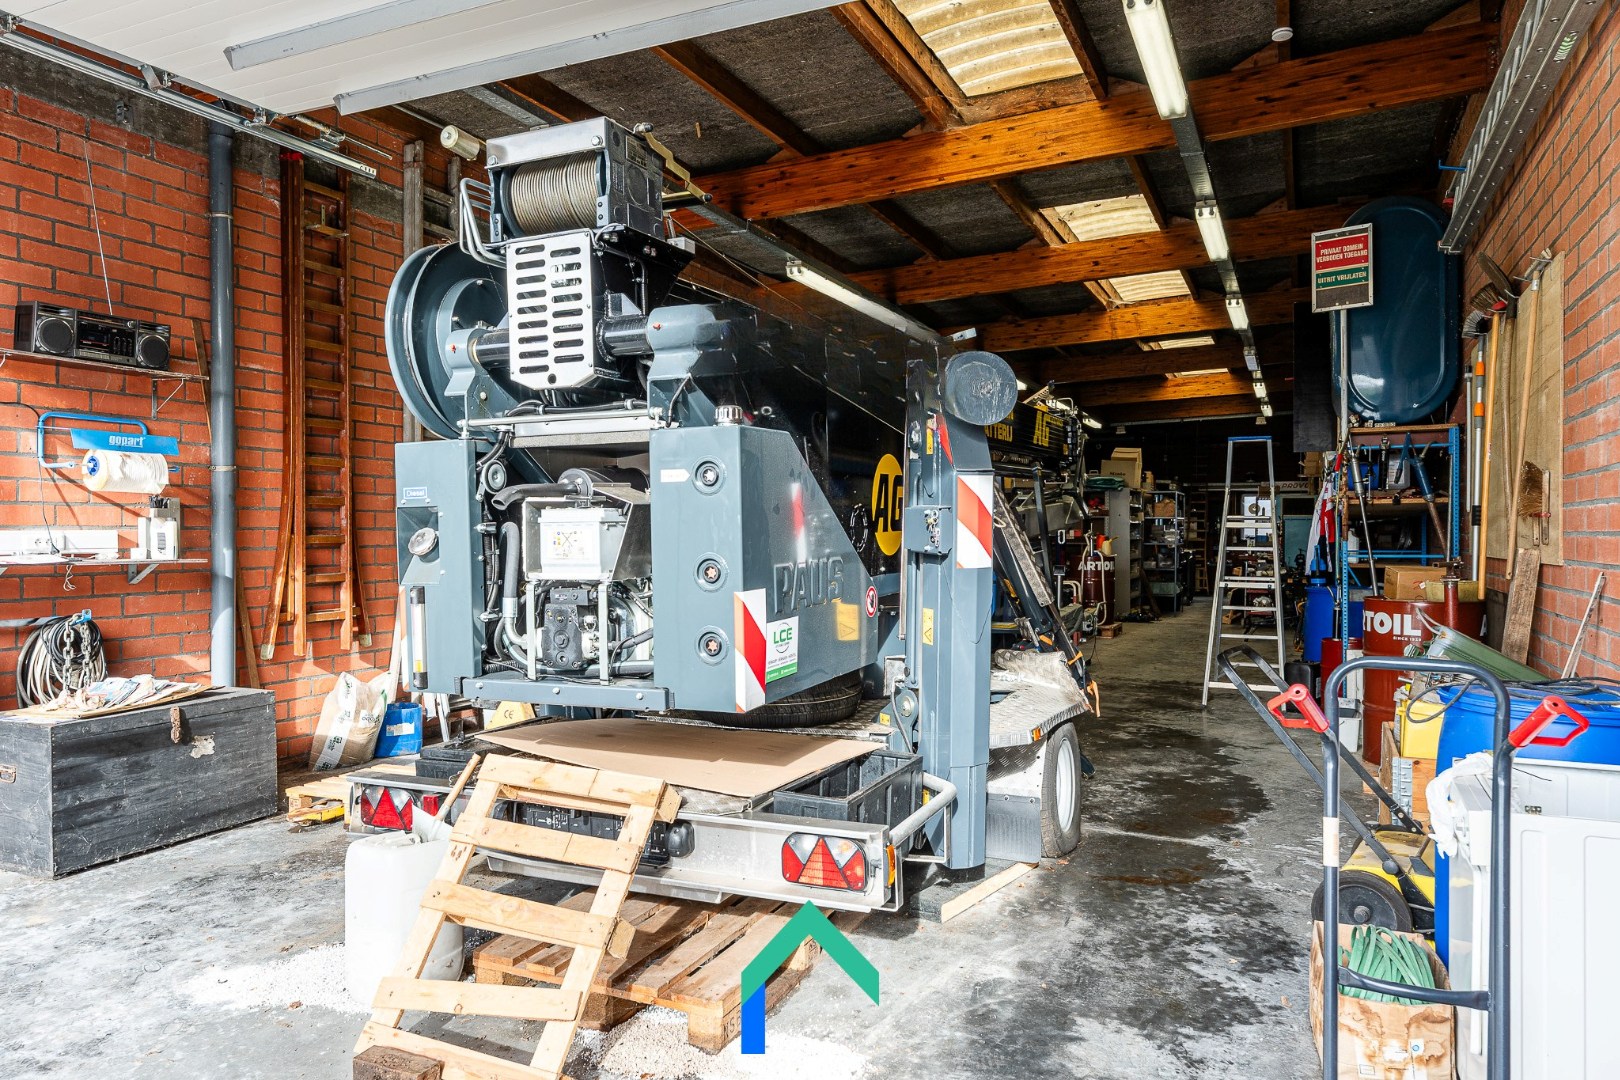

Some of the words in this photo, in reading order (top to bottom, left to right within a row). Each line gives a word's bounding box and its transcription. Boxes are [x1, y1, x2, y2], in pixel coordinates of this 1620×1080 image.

[1316, 254, 1342, 262] VERBODEN
[1344, 250, 1367, 258] TOEGANG
[1320, 246, 1341, 255] PRIVAAT
[1343, 243, 1363, 251] DOMEIN
[1337, 271, 1366, 280] VRIJLATEN
[1033, 410, 1050, 447] AG
[874, 474, 903, 532] AG
[774, 556, 844, 615] PAUS
[773, 627, 793, 645] LCE
